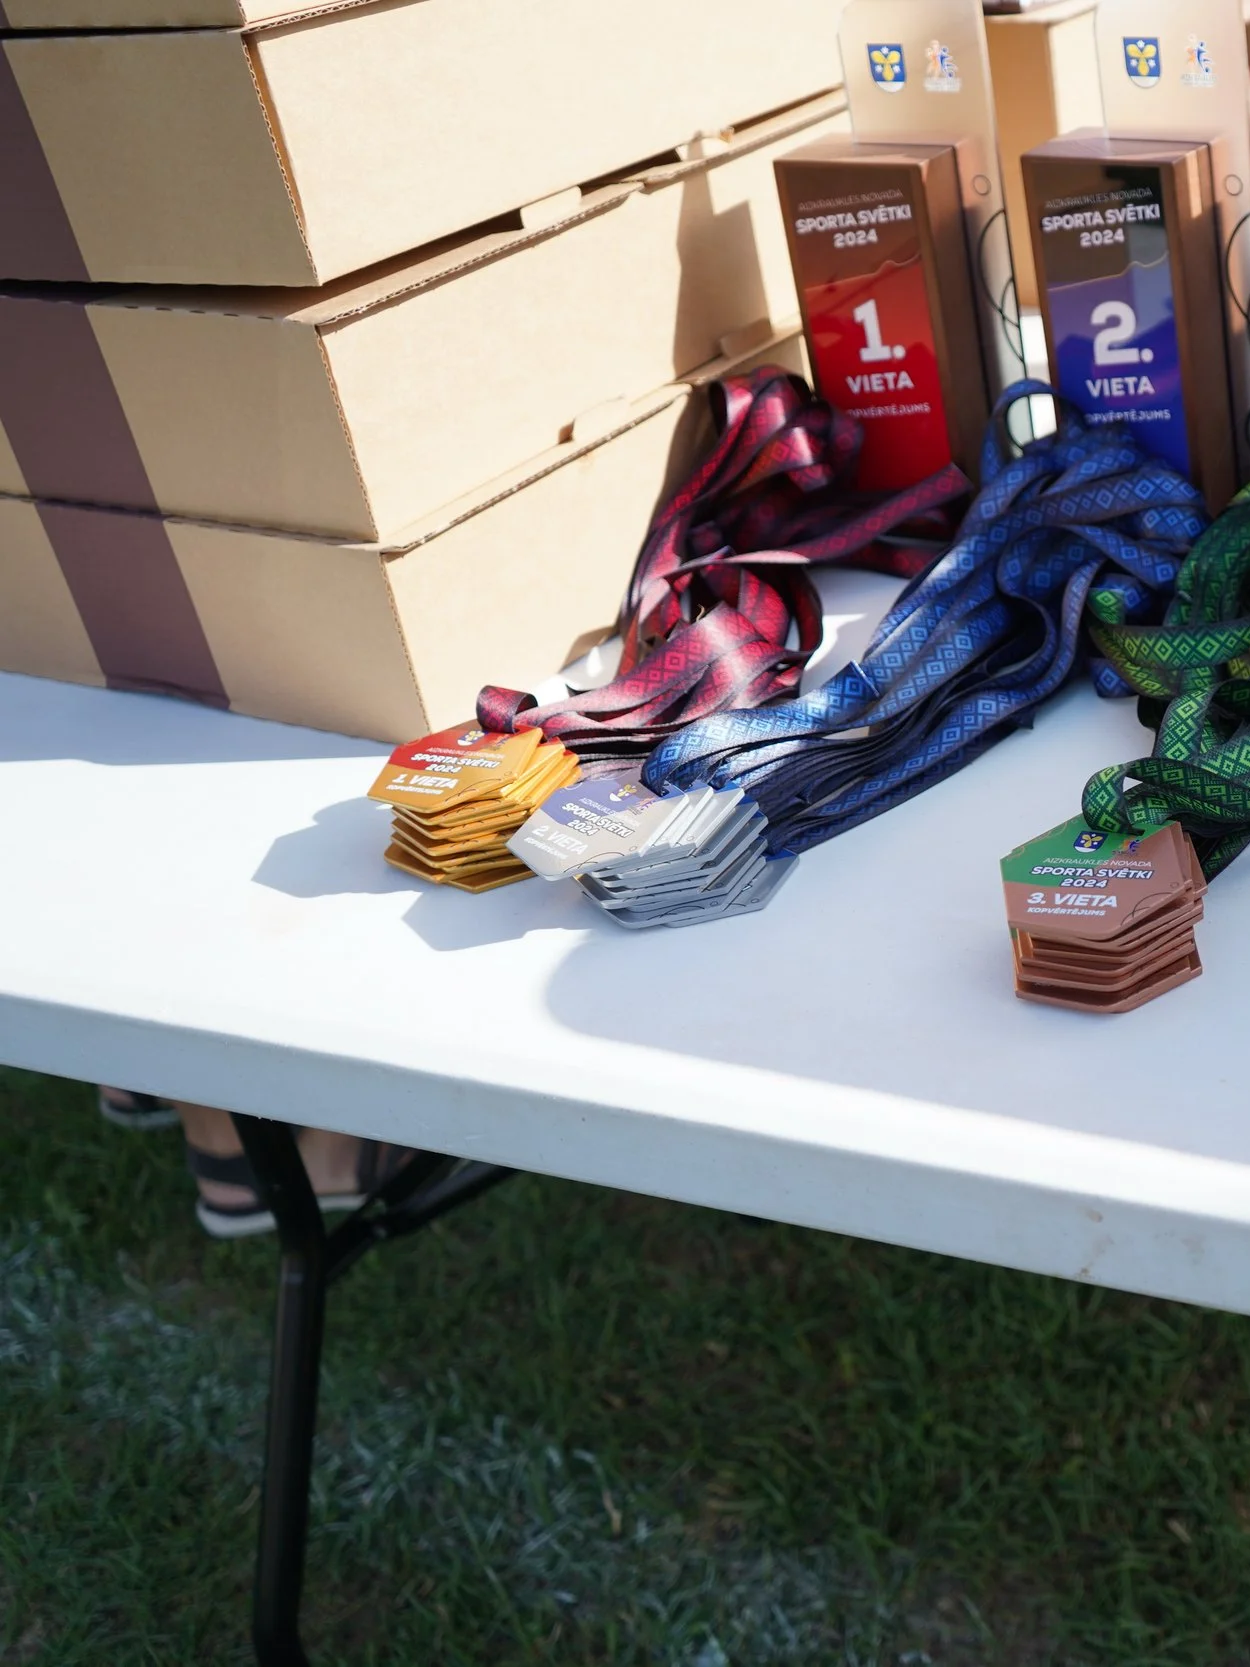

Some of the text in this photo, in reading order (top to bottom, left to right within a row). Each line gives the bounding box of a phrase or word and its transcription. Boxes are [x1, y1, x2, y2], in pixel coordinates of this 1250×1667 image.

[795, 204, 912, 234] SPORTA SVĒTKI
[1041, 203, 1161, 233] SPORTA SVĒTKI
[833, 228, 878, 248] 2024
[1079, 228, 1125, 248] 2024
[853, 299, 906, 362] 1.
[1090, 300, 1154, 366] 2.
[846, 371, 914, 395] VIETA
[1085, 376, 1155, 398] VIETA
[411, 753, 457, 764] SPORTA
[456, 758, 502, 769] SVĒTKI
[425, 763, 462, 774] 2024
[409, 775, 459, 789] VIETA
[562, 802, 601, 824] SPORTA
[597, 817, 636, 838] SVĒTKI
[567, 819, 600, 836] 2024
[547, 831, 589, 855] VIETA
[1042, 857, 1152, 868] AIZKRAUKLES NOVADA
[1031, 866, 1153, 880] SPORTA SVĒTKI
[1060, 878, 1109, 889] 2024
[1027, 891, 1118, 908] 3. VIETA
[1027, 906, 1106, 917] KOPVĒRTĒJUMS
